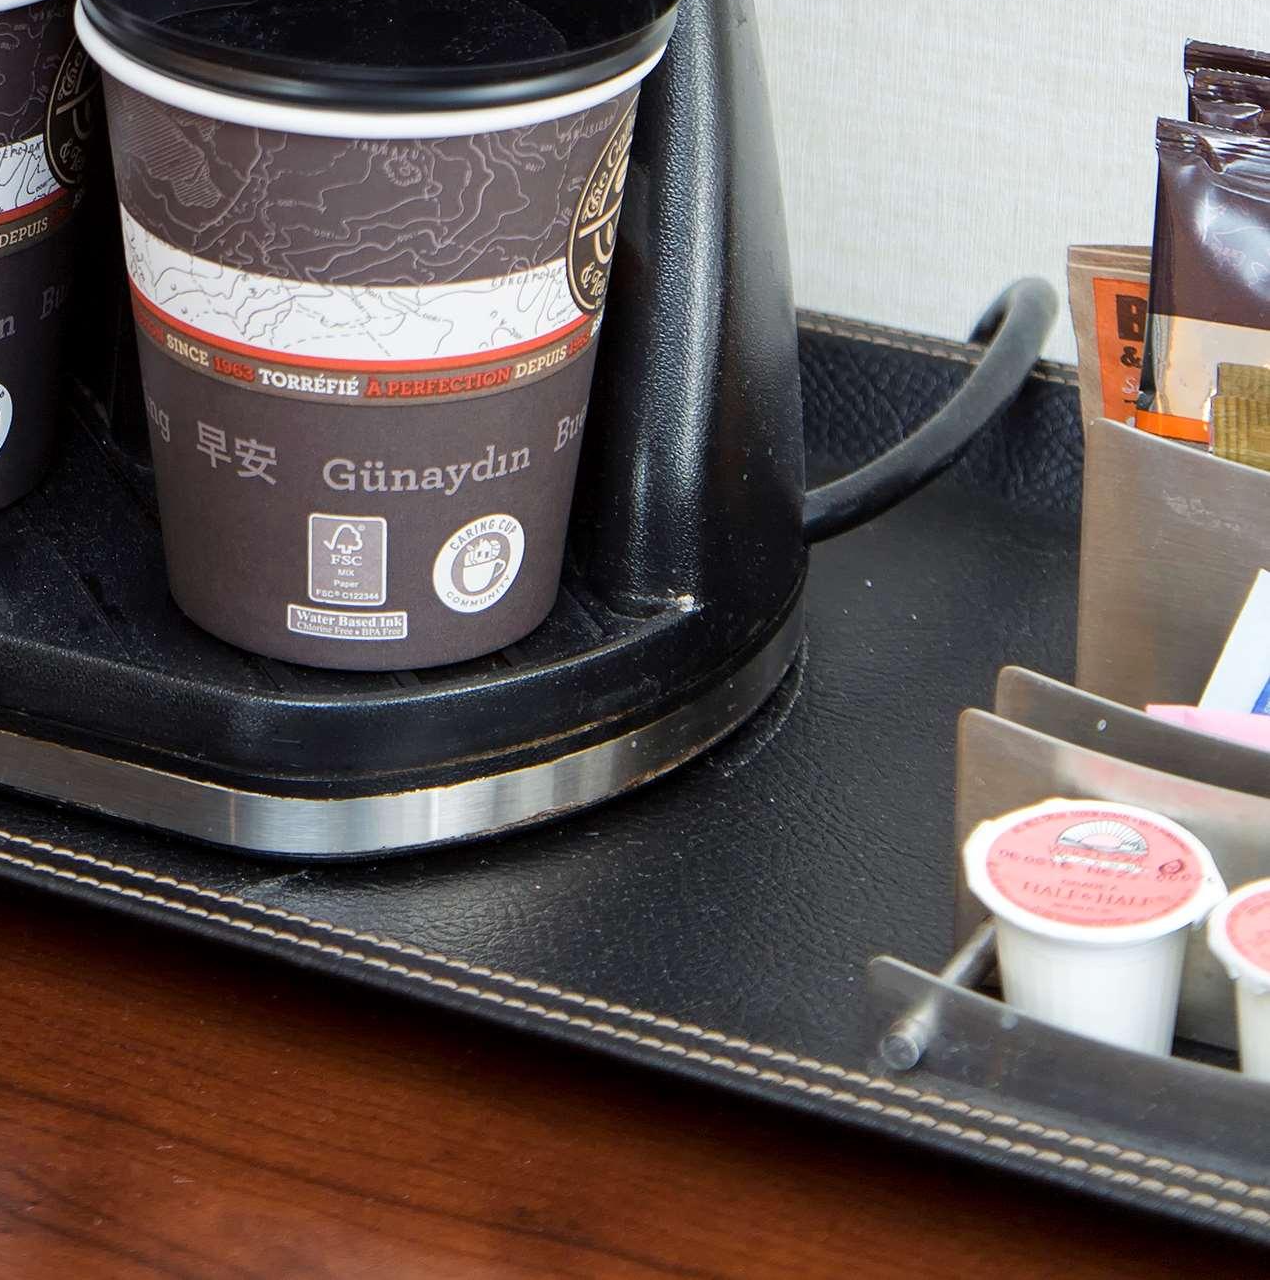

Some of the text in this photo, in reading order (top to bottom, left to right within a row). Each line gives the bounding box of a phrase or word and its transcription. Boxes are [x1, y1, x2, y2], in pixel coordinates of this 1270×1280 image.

[167, 333, 209, 367] SINCE
[213, 356, 255, 383] 1963
[258, 368, 359, 396] TORRÉFIÉ
[365, 376, 383, 398] À
[386, 366, 513, 397] PERFECTION
[515, 344, 568, 380] DEPUIS
[197, 420, 277, 486] 早安
[323, 445, 530, 496] Günaydın
[450, 518, 517, 550] CARING CUP
[331, 554, 363, 566] FSC
[333, 580, 359, 589] Paper
[446, 575, 510, 607] COMMUNITY
[297, 610, 403, 627] Water Based Ink
